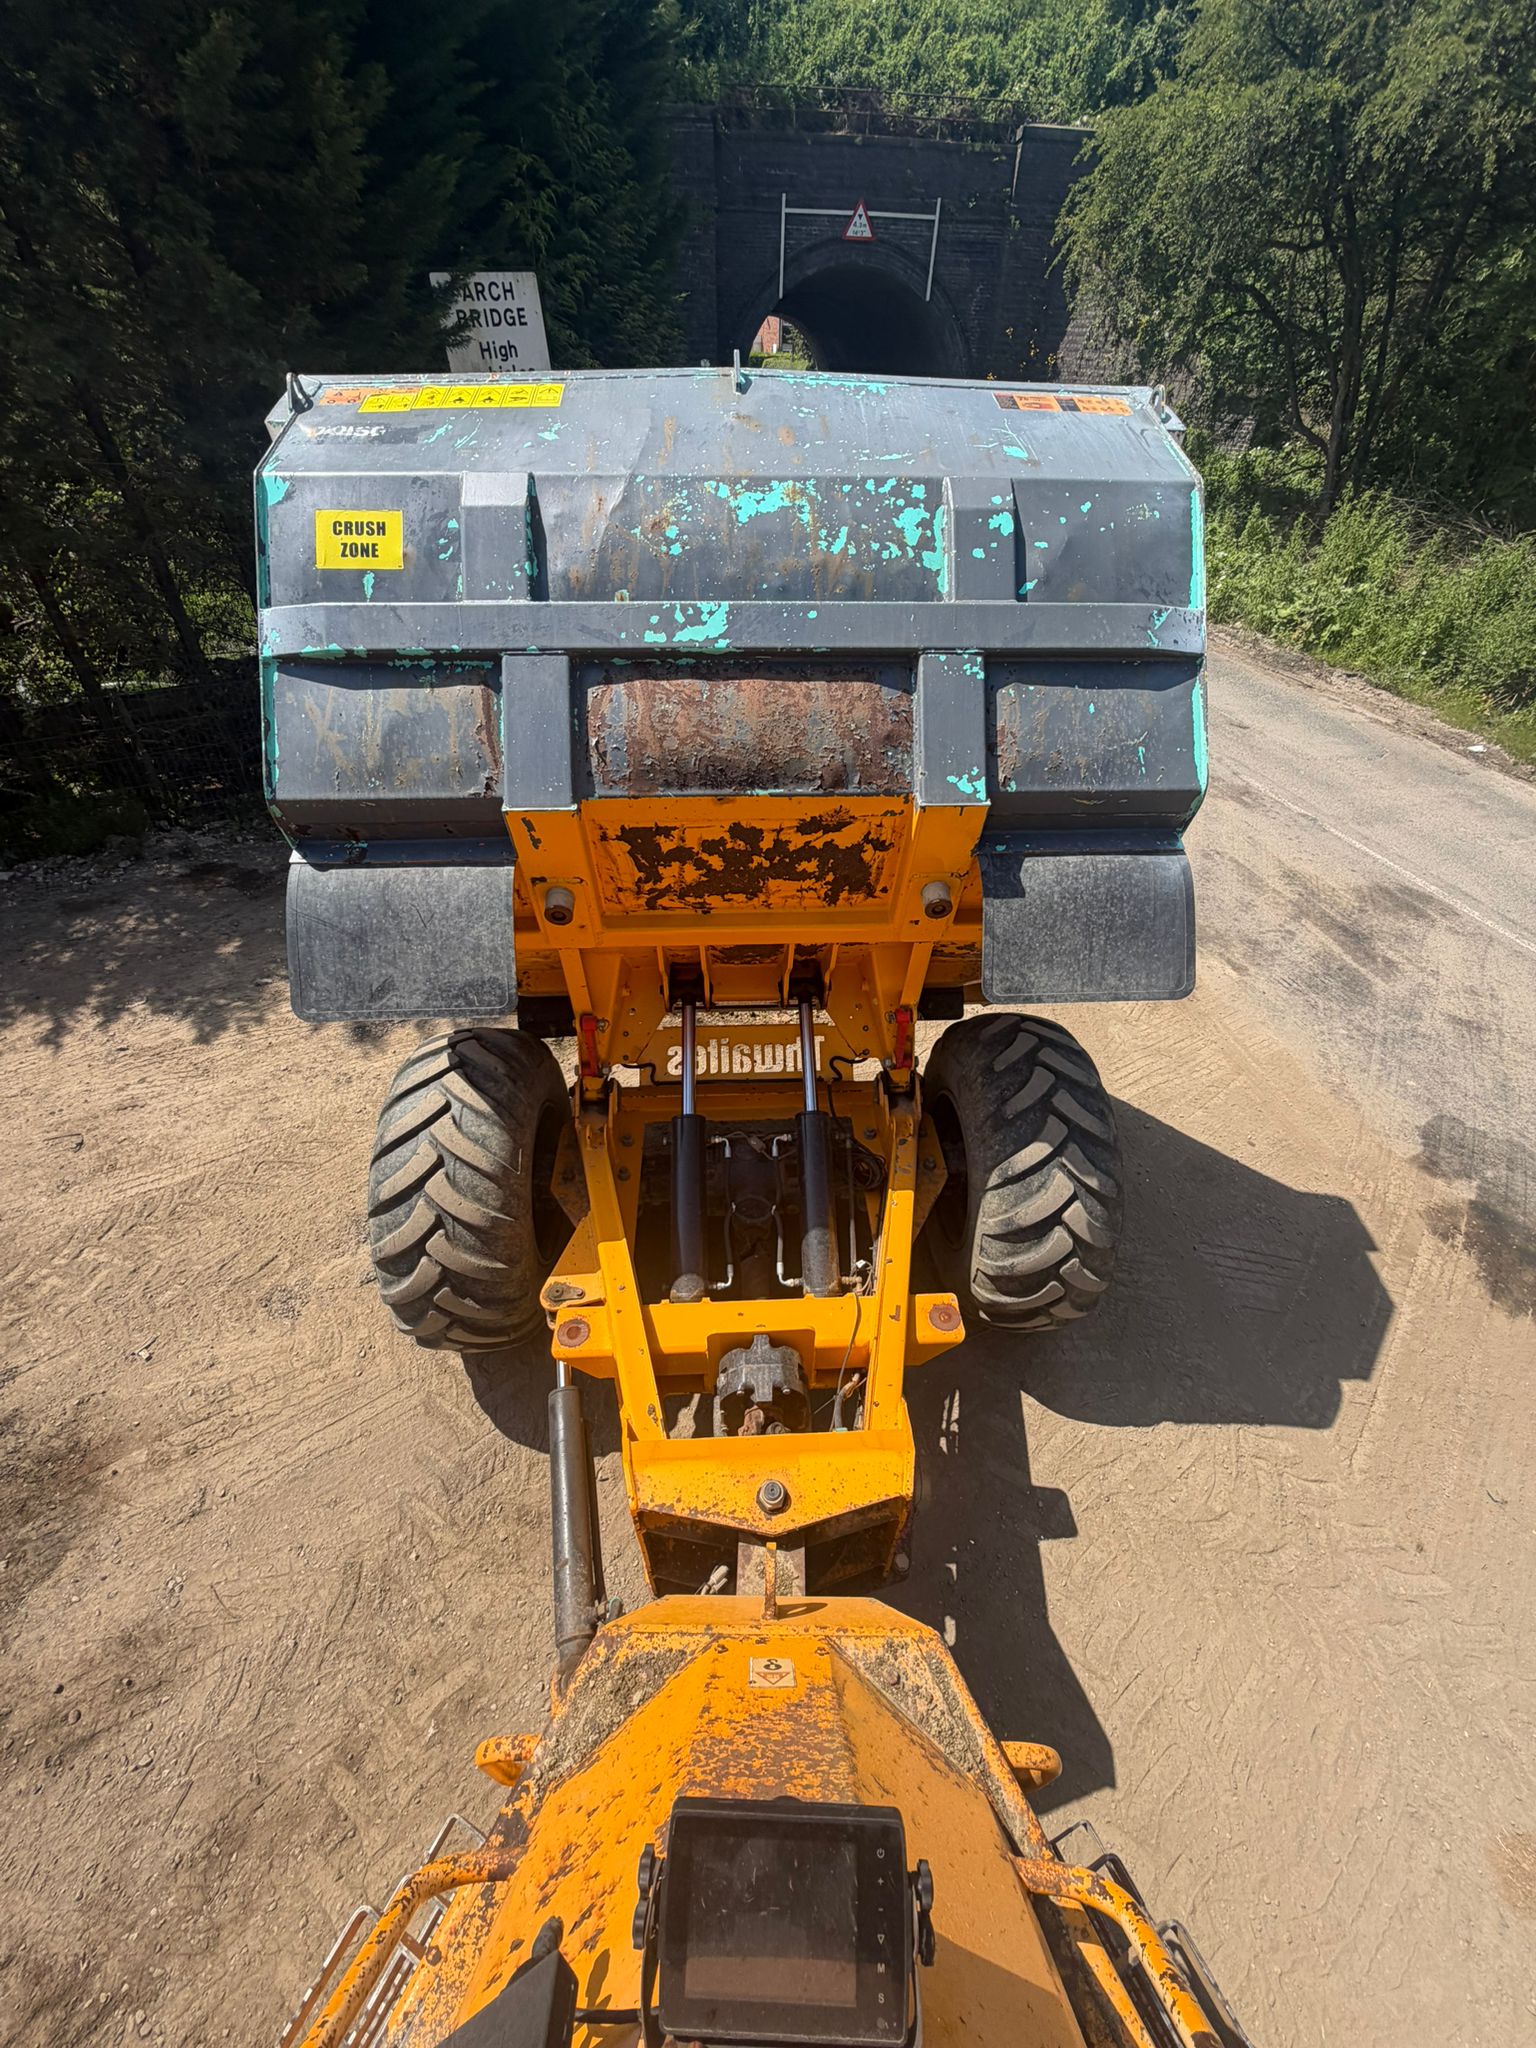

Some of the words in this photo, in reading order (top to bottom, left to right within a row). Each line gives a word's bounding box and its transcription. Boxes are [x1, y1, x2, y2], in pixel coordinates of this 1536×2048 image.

[463, 281, 515, 302] ARCH
[479, 340, 518, 362] High
[332, 520, 386, 536] CRUSH
[340, 542, 379, 558] ZONE
[877, 1962, 886, 1974] M
[878, 1992, 885, 2004] S
